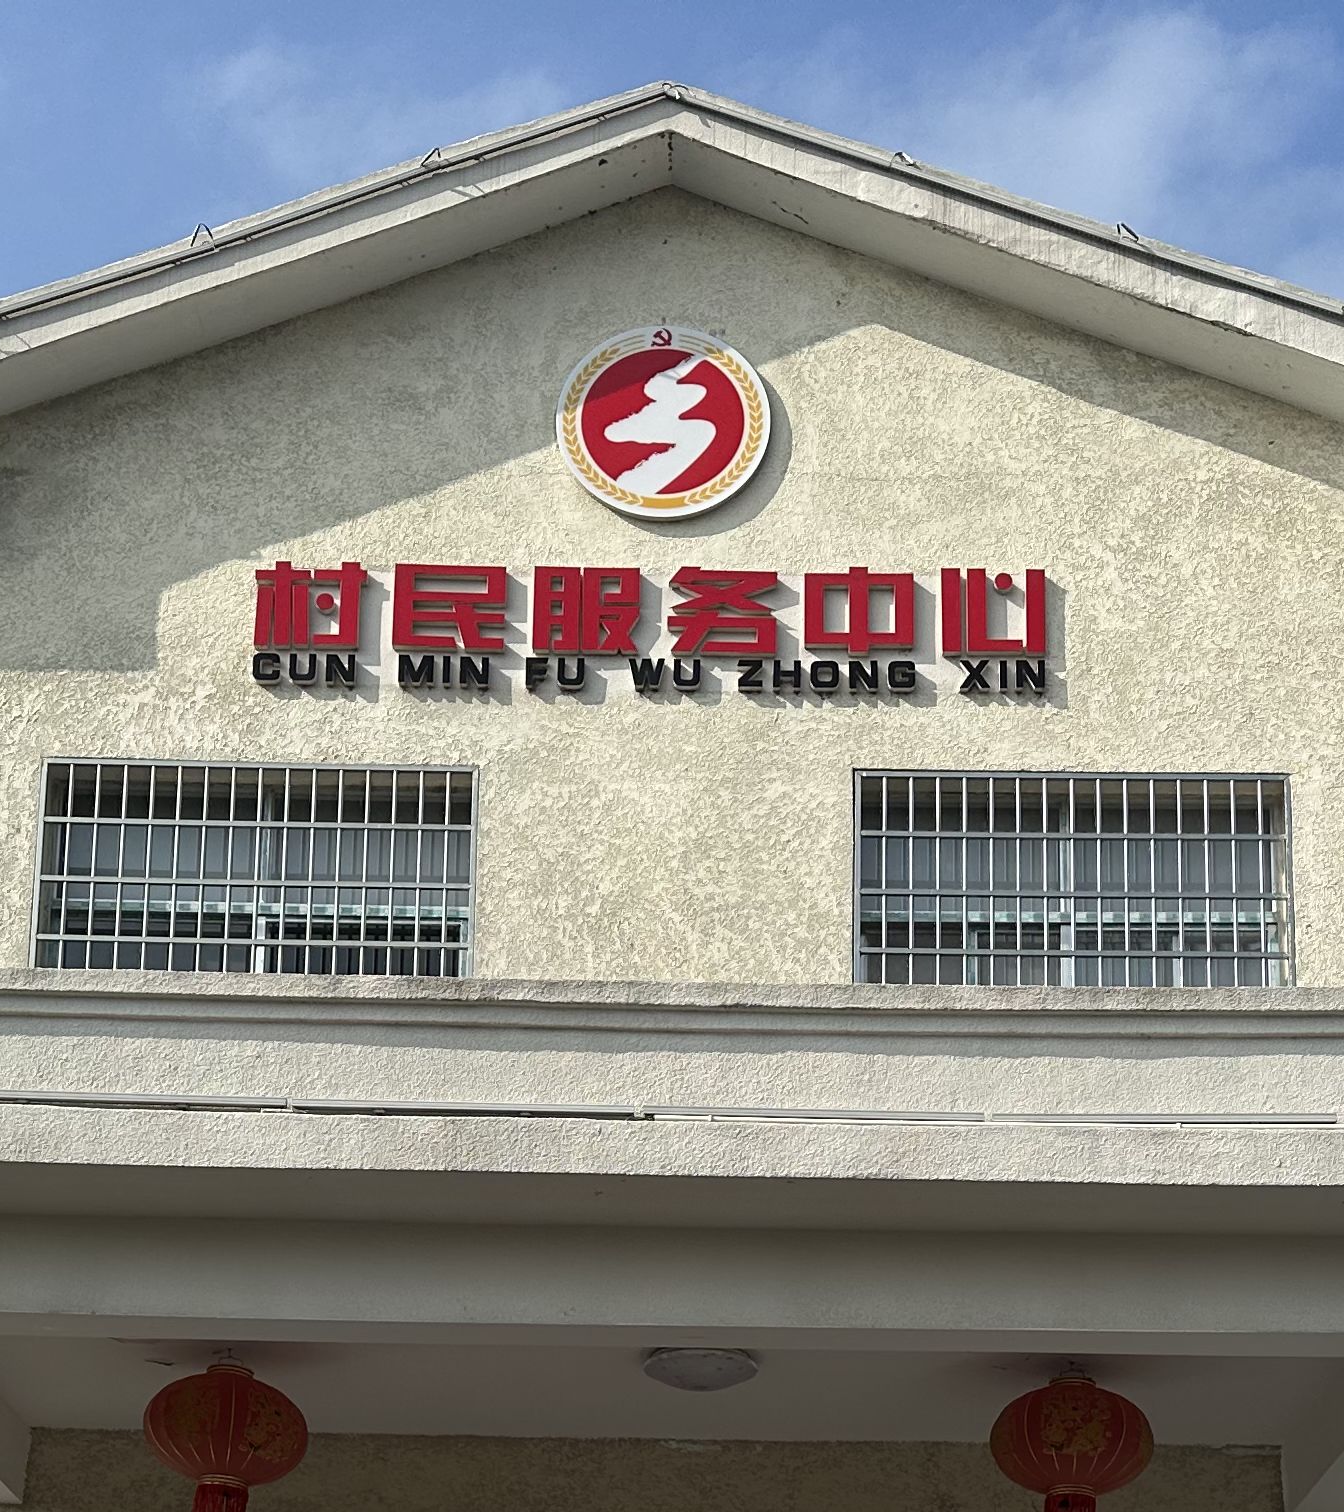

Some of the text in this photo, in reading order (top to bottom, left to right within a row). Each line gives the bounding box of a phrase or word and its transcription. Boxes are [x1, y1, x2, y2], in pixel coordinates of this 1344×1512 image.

[253, 561, 1046, 656] 村民服务中心
[252, 652, 1047, 692] CUN MIN FU WU ZHONG XIN
